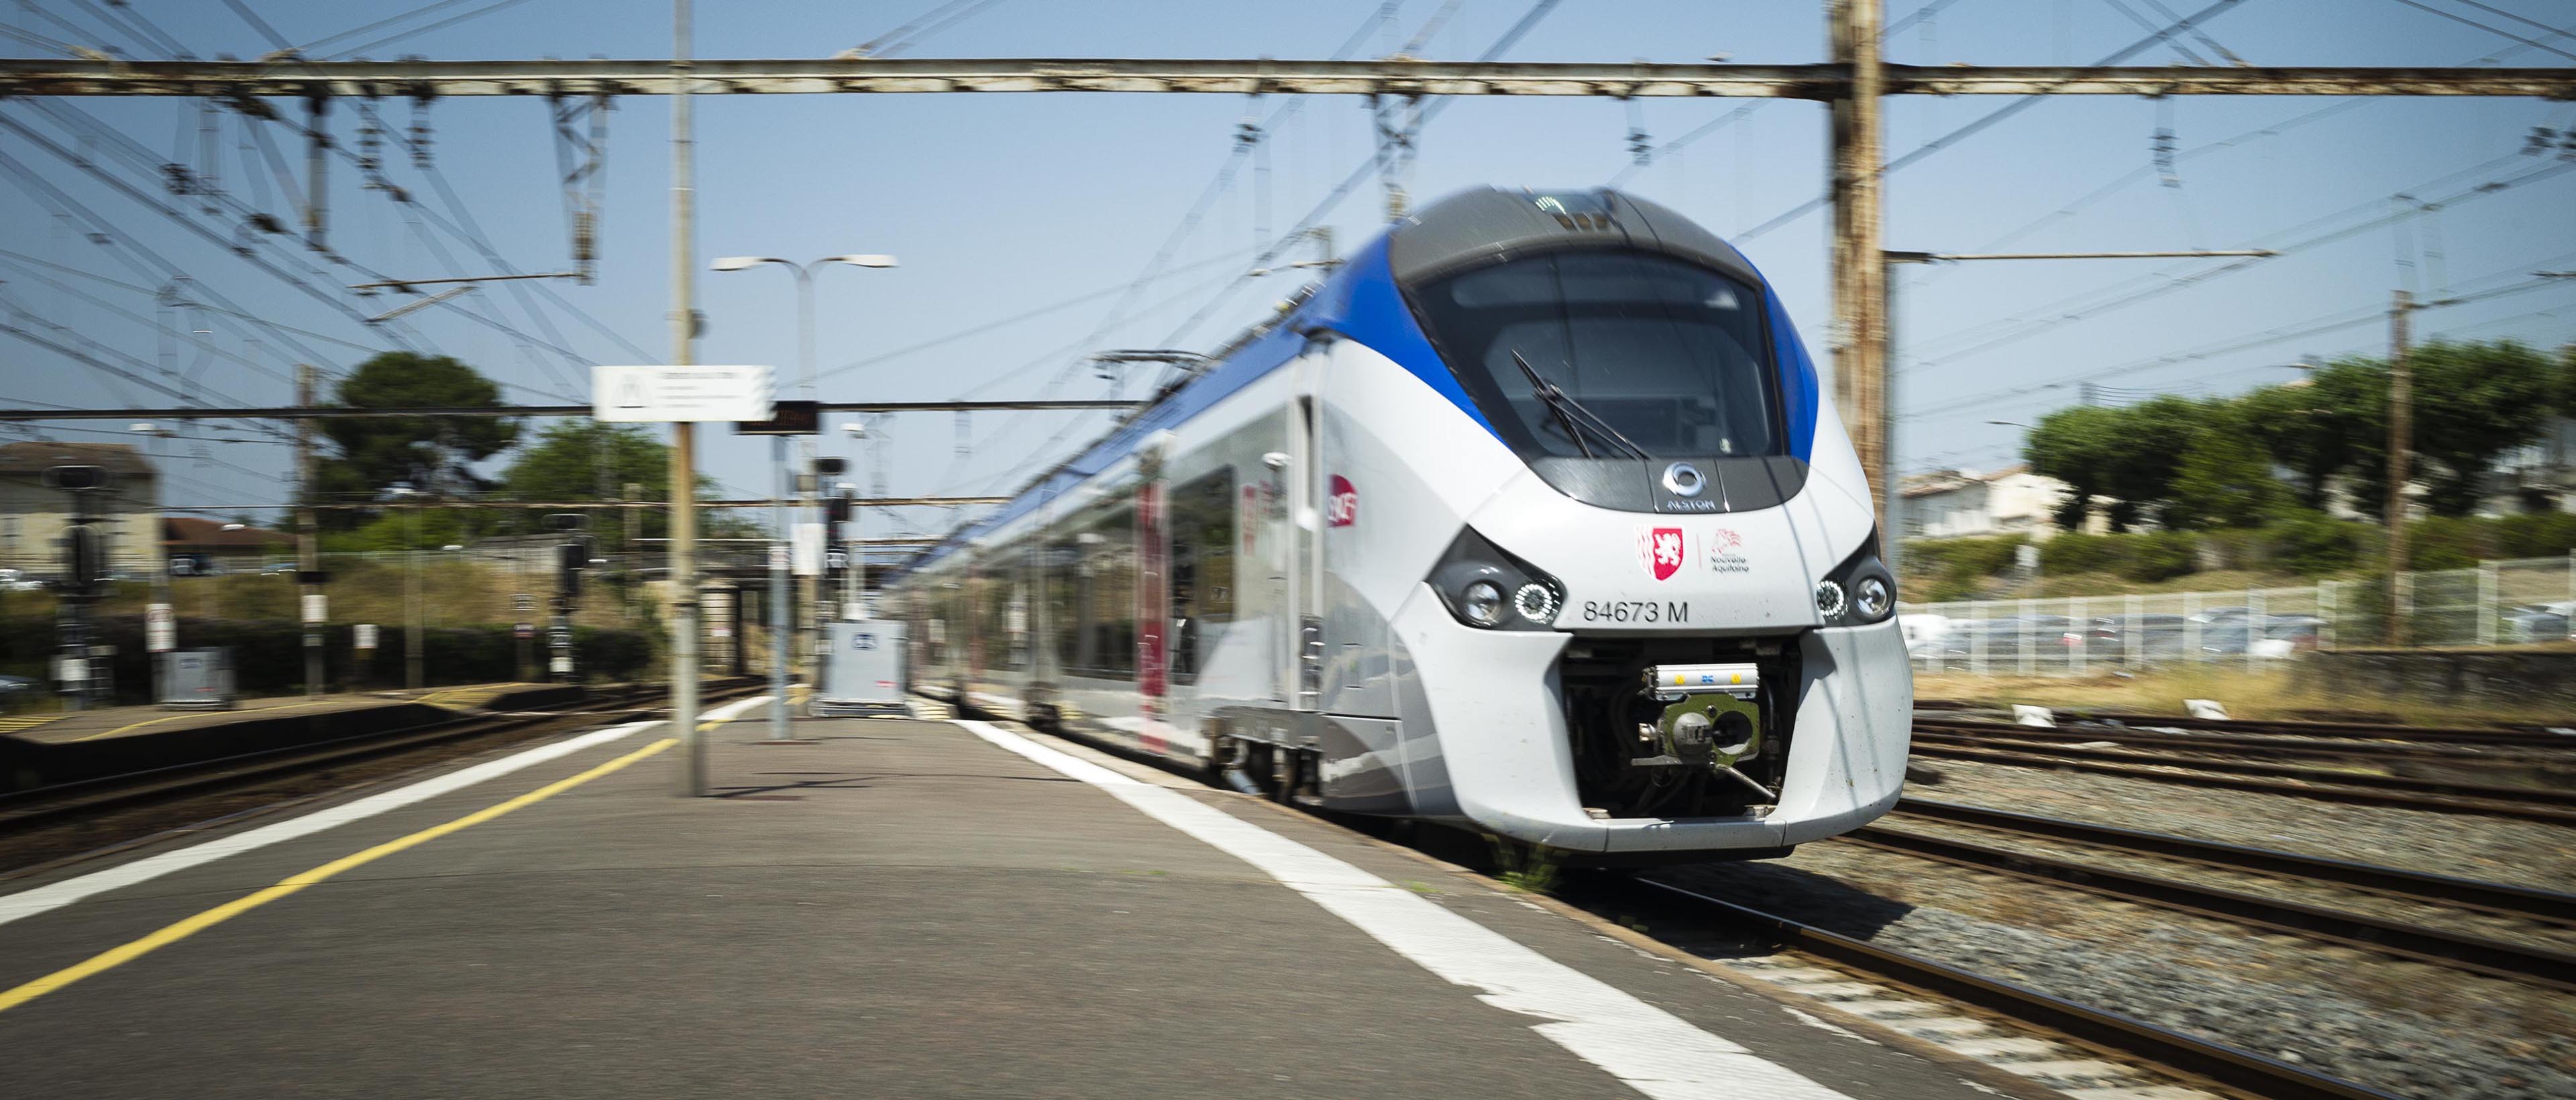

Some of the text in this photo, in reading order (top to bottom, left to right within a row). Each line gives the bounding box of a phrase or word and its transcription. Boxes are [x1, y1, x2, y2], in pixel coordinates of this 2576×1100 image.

[1667, 500, 1716, 510] ALSTOM
[1583, 601, 1688, 622] 84673 M
